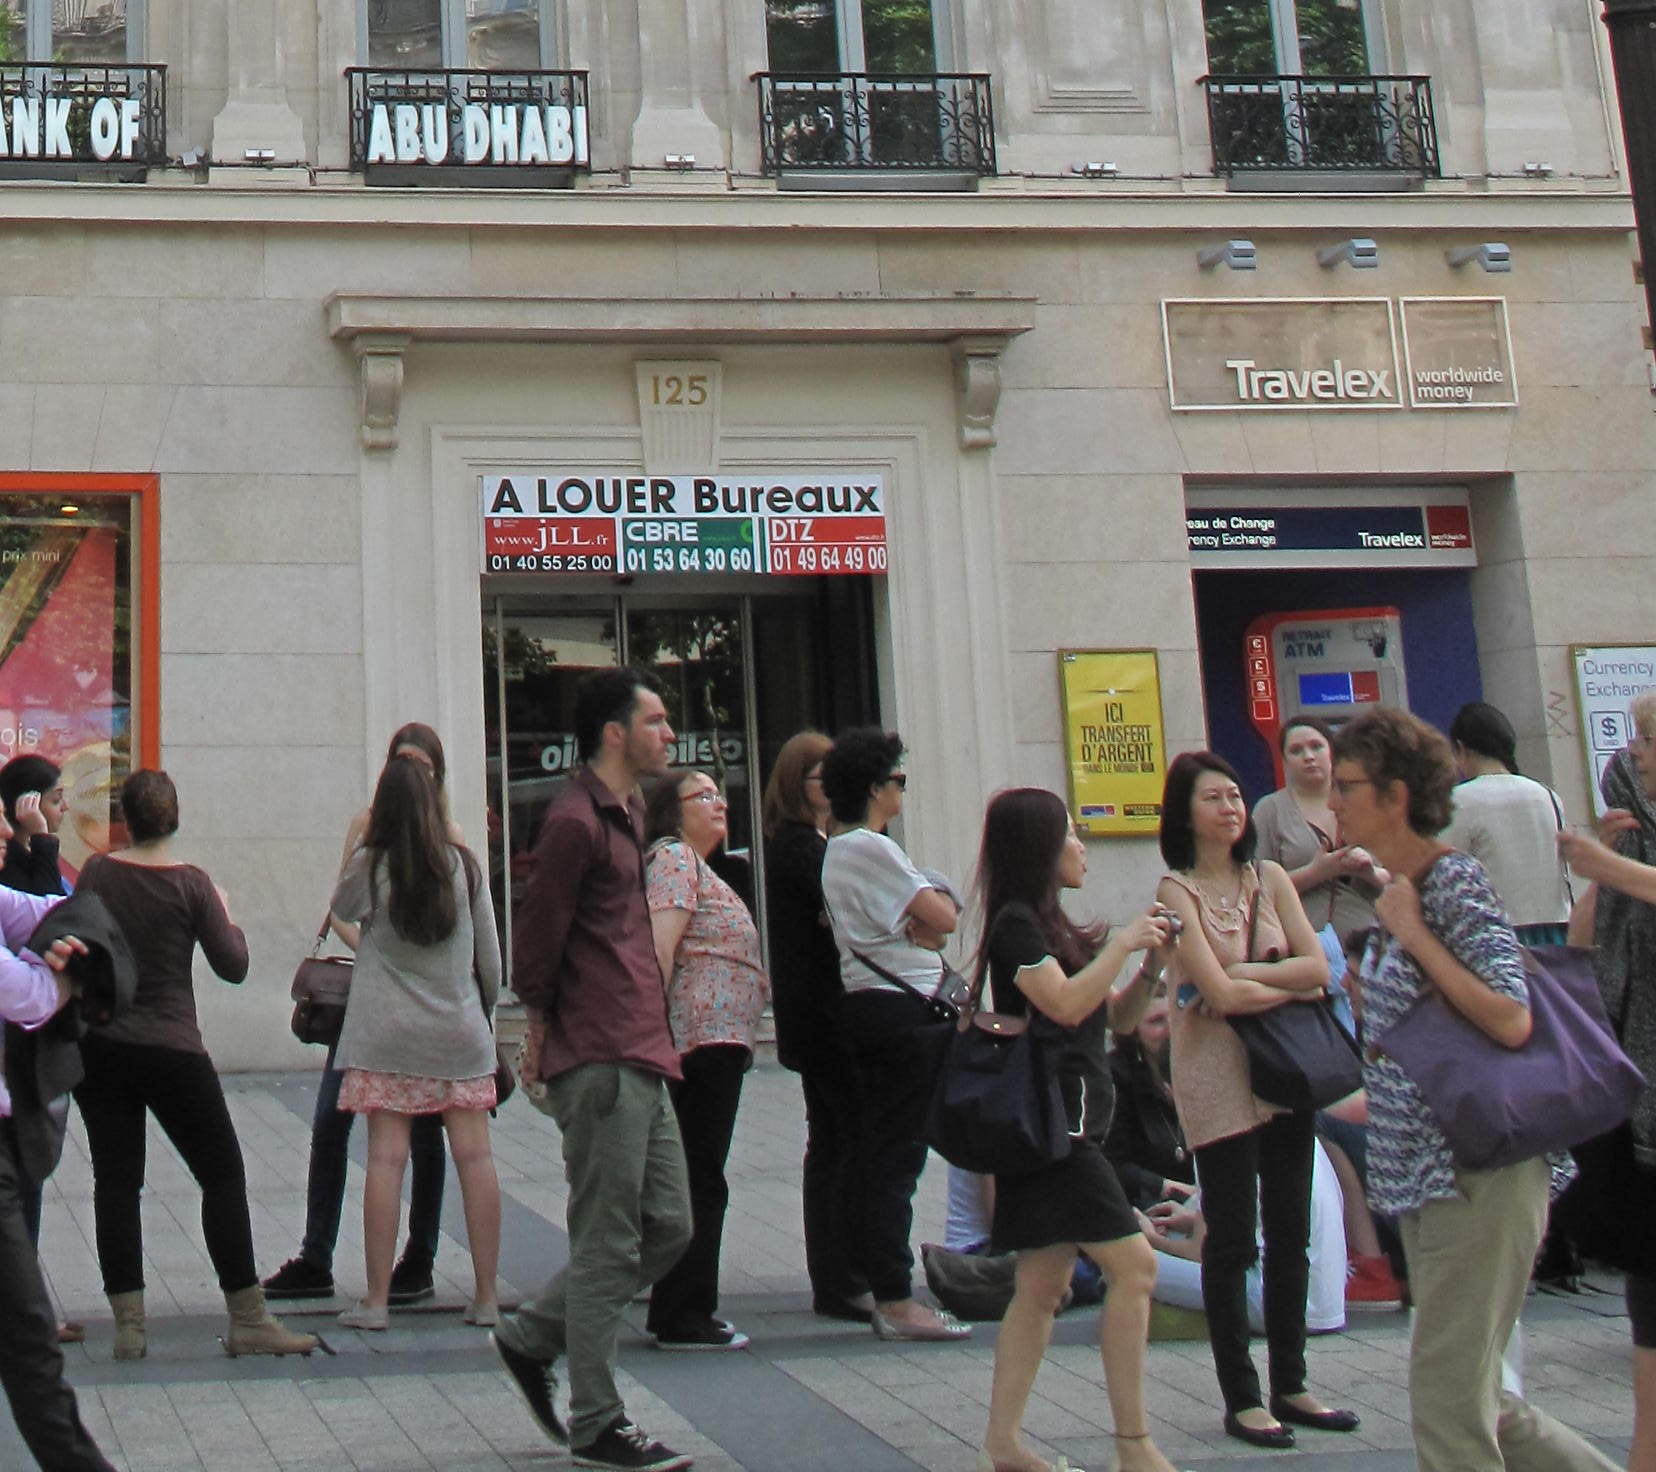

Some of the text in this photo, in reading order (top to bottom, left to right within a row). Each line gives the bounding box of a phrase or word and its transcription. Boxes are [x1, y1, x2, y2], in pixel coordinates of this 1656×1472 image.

[91, 98, 141, 161] OF
[368, 103, 448, 166] ABU
[463, 104, 587, 165] DHABI
[1226, 359, 1393, 400] Travelex
[1416, 367, 1504, 384] worldwide
[651, 375, 708, 405] 125
[1417, 385, 1474, 402] money
[490, 477, 880, 514] A LOUER Bureaux
[626, 522, 698, 543] CBRE
[771, 519, 815, 541] DTZ
[1230, 516, 1276, 532] Change
[1222, 533, 1277, 548] Exchange
[1358, 532, 1425, 547] Travelex
[31, 550, 60, 561] mini
[491, 555, 612, 571] 01 40 55 25 00
[626, 547, 751, 571] 01 53 64 30 60
[773, 547, 887, 571] 01 49 64 49 00
[1284, 643, 1325, 658] ATM
[1583, 659, 1654, 677] Currency
[1586, 681, 1656, 697] Exchan
[1104, 702, 1124, 723] ICI
[1080, 725, 1152, 743] TRANSFERT
[1081, 742, 1153, 762] D'ARGENT
